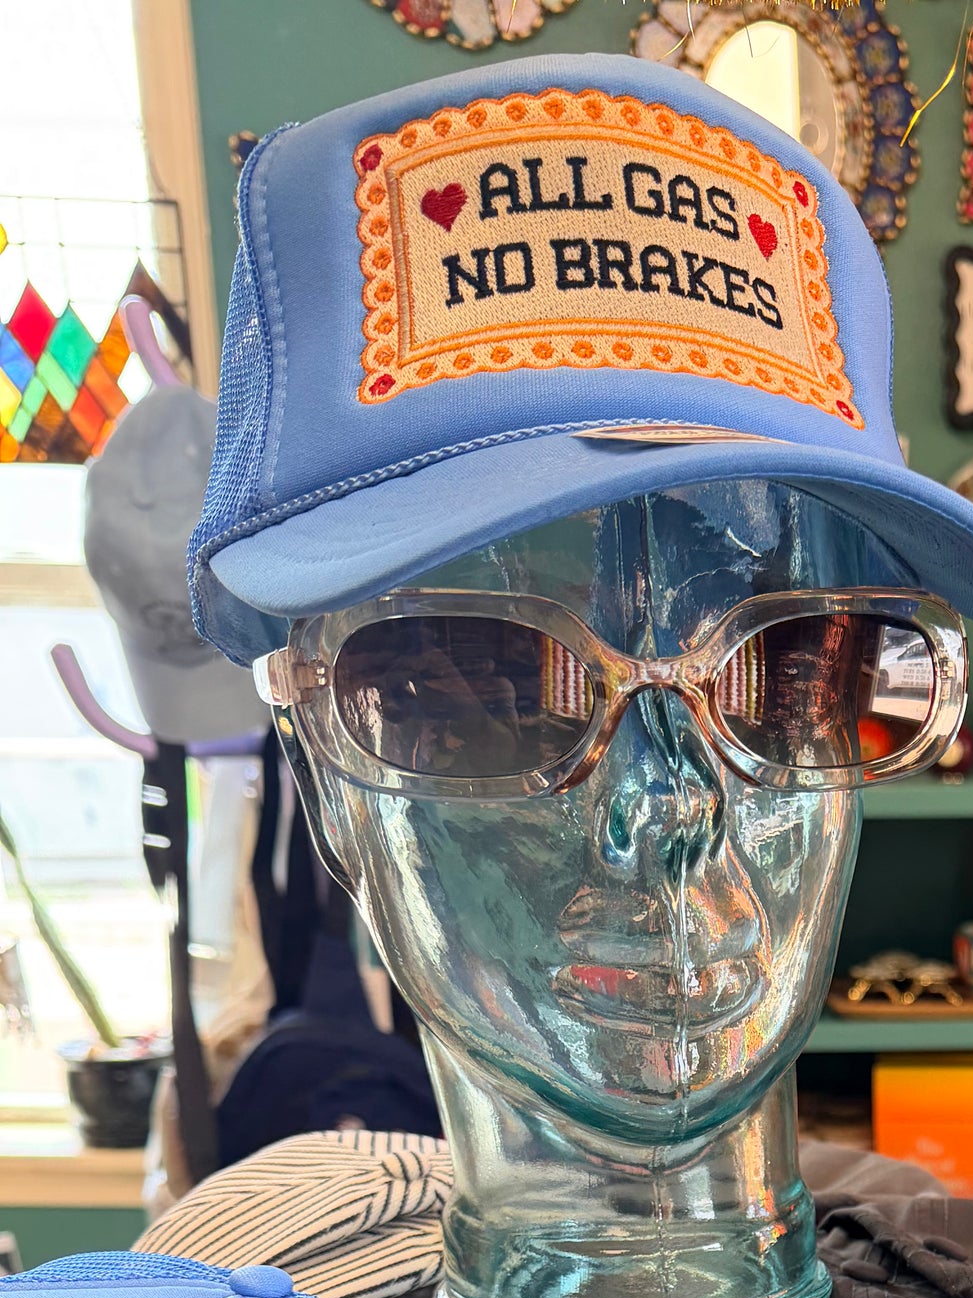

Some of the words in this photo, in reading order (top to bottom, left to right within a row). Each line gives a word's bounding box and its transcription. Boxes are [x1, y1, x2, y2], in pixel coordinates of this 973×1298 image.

[479, 157, 613, 220] ALL
[623, 162, 740, 241] GAS
[442, 241, 536, 309] NO
[550, 238, 784, 330] BRAKES
